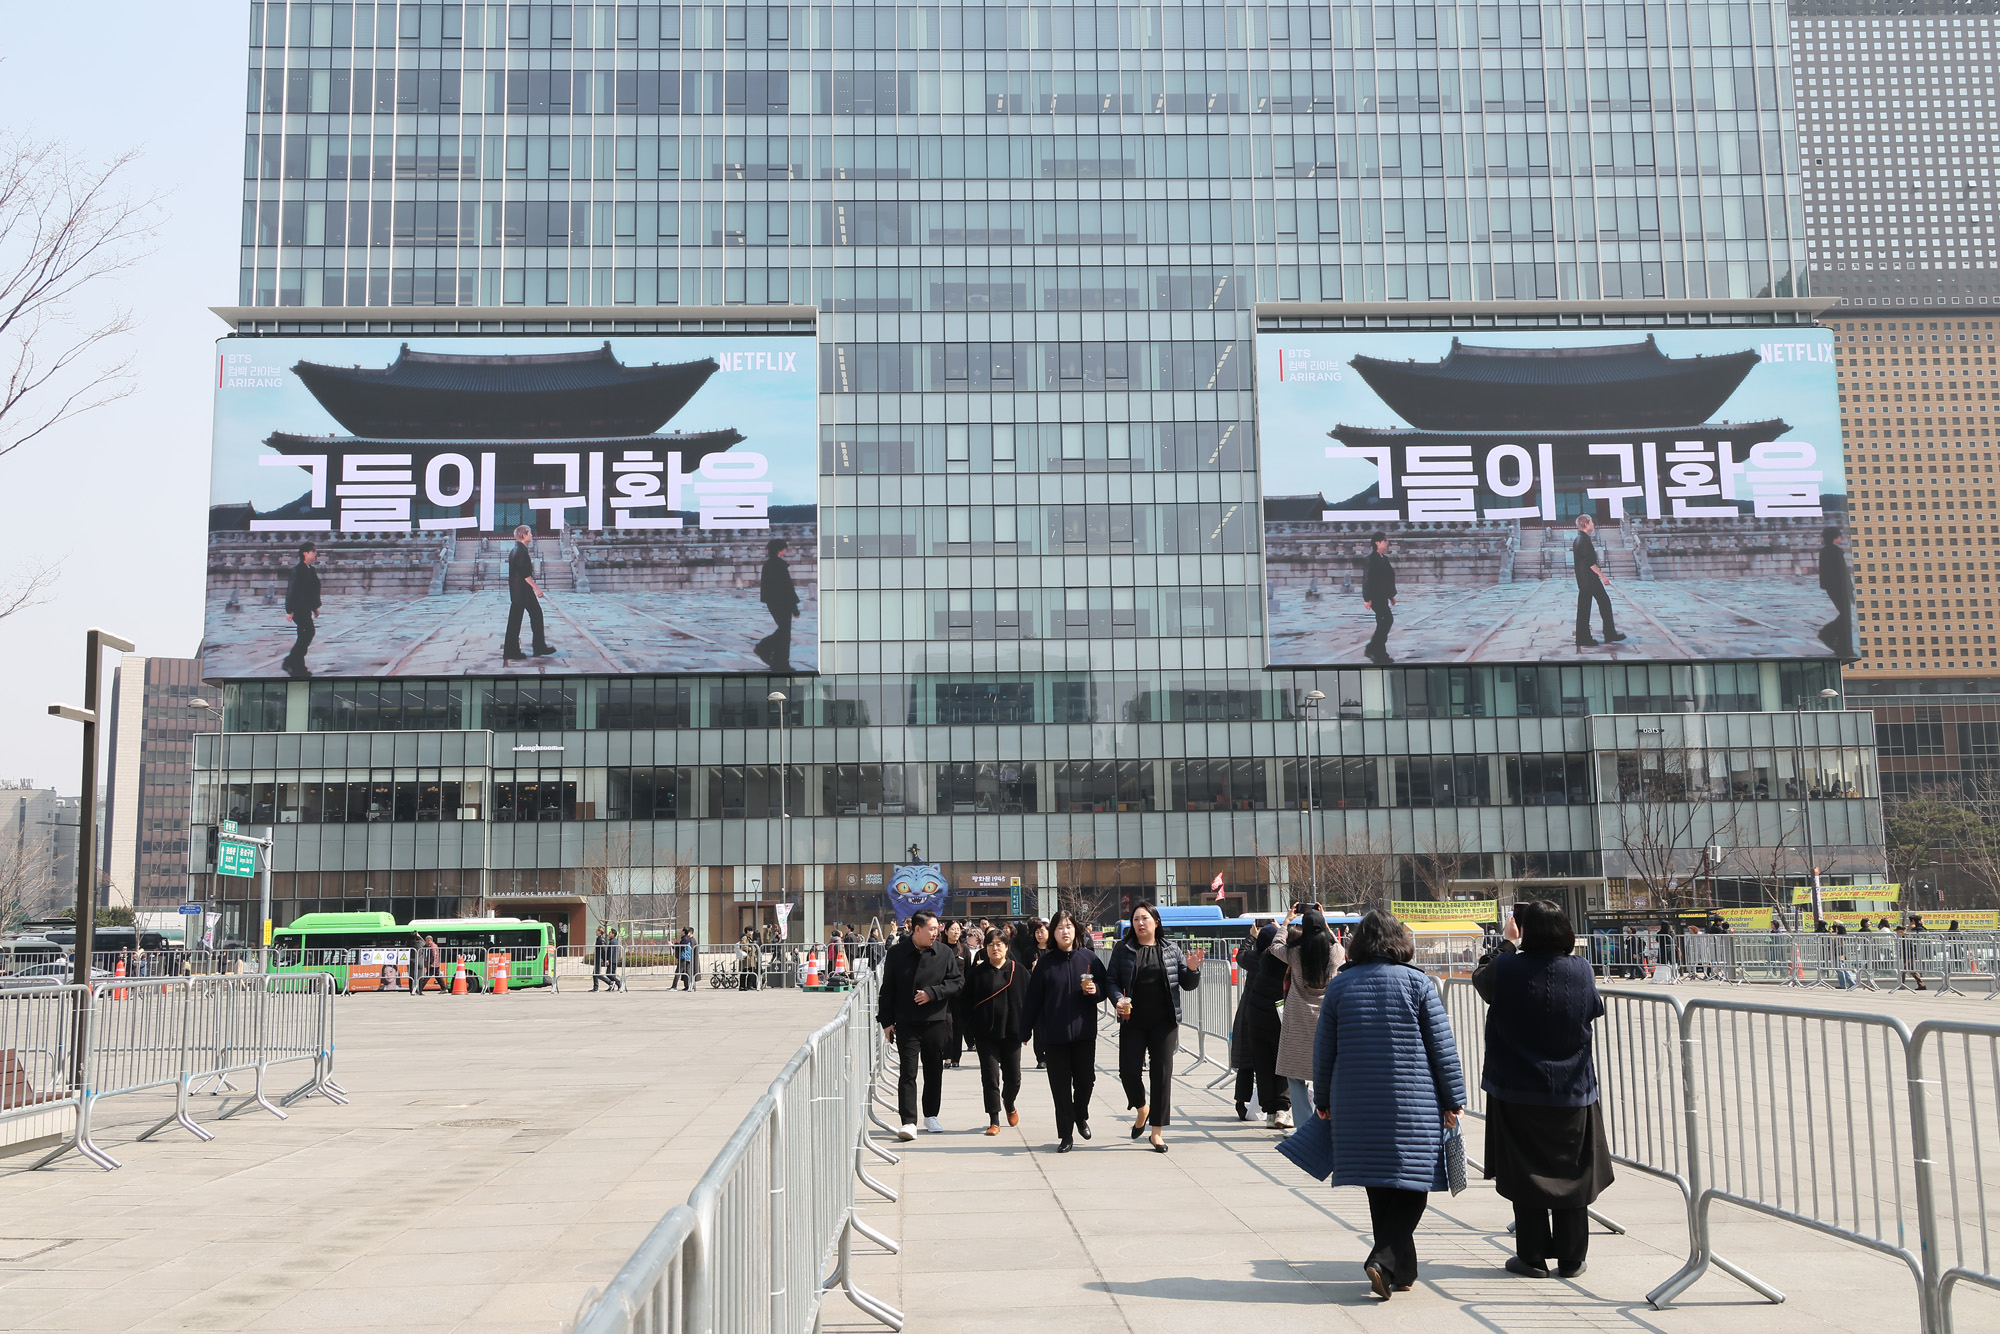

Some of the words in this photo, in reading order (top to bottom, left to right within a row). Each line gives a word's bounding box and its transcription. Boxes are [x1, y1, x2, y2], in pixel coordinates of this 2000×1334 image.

[228, 354, 252, 364] BTS
[1288, 349, 1311, 358] BTS
[1760, 343, 1834, 364] NETFLIX
[719, 352, 797, 373] NETFLIX
[1289, 360, 1307, 371] 컴백
[1310, 360, 1339, 371] 라이브
[227, 366, 247, 377] 컴백
[250, 366, 280, 377] 라이브
[1289, 372, 1342, 382] ARIRANG
[227, 378, 283, 388] ARIRANG
[1322, 443, 1556, 522] 그들의
[1587, 441, 1824, 520] 귀환을
[250, 452, 496, 532] 그들의
[528, 451, 774, 531] 귀환을
[1873, 912, 1898, 920] People!
